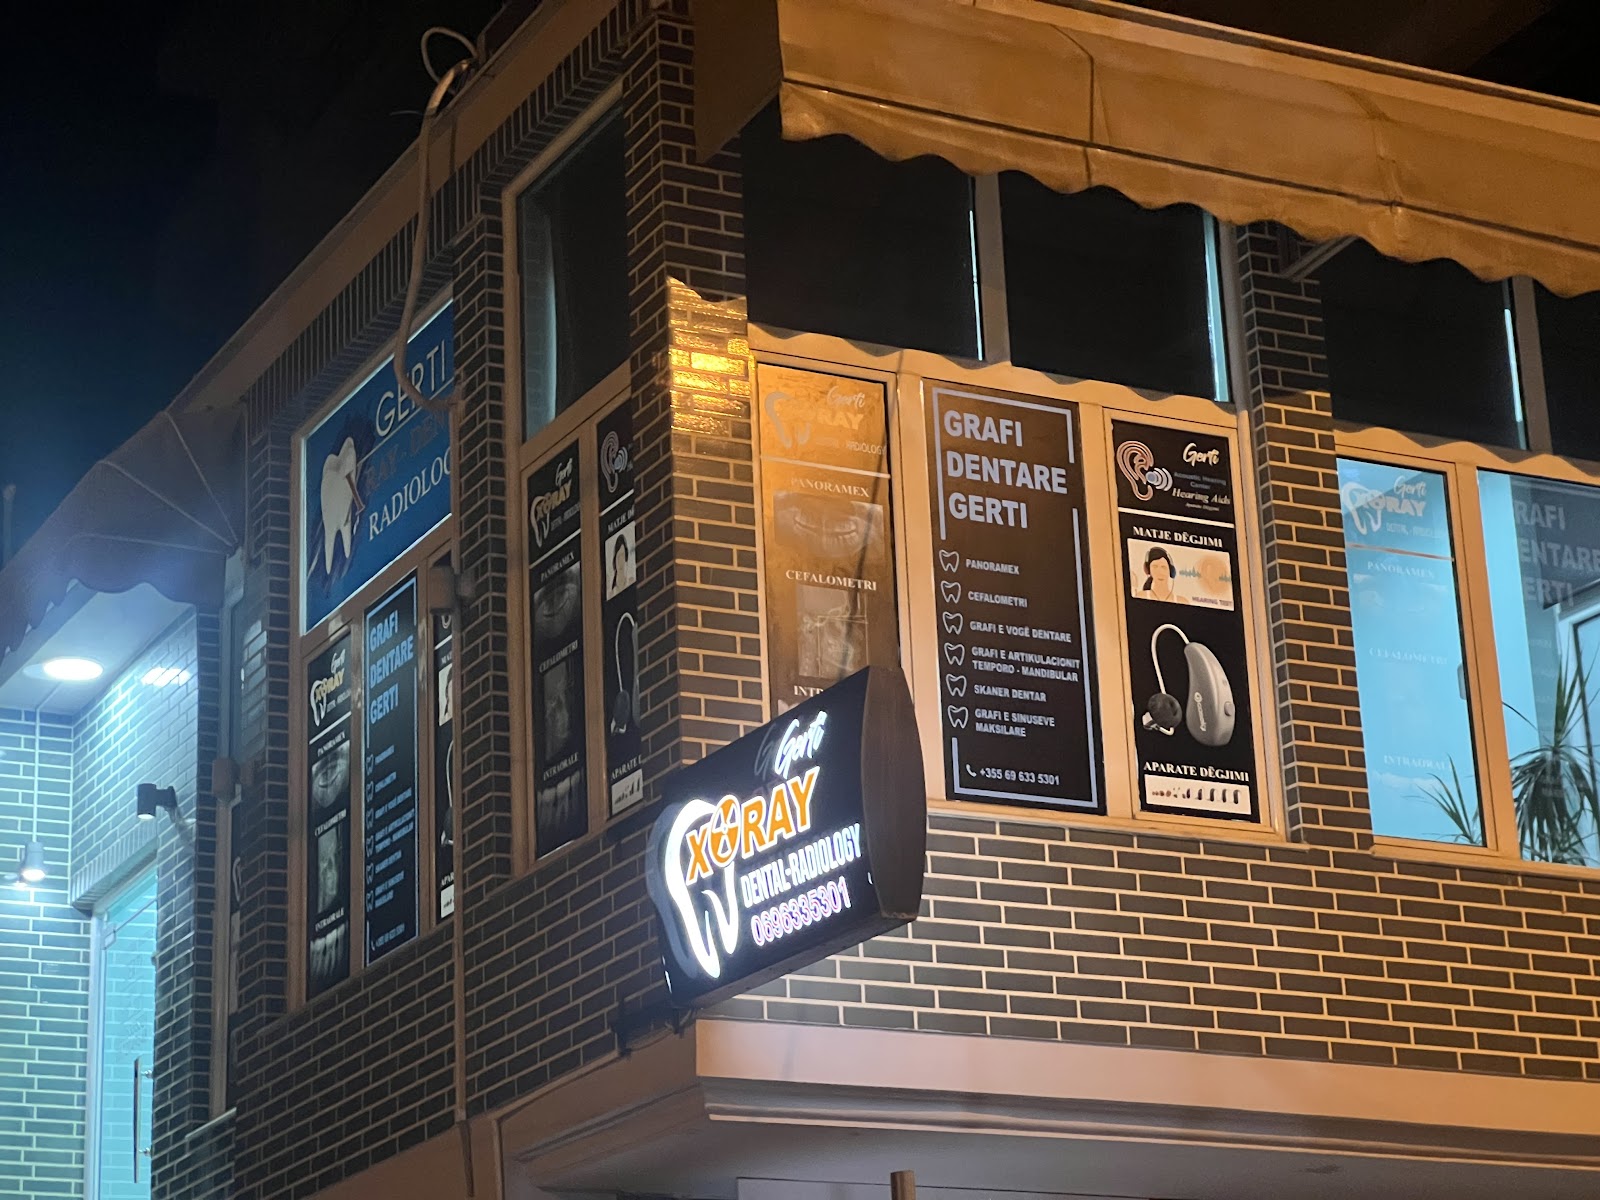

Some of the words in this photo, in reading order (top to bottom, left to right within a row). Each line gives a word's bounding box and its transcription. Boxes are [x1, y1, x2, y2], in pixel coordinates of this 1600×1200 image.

[817, 410, 864, 430] RAY
[944, 410, 1022, 447] GRAFI
[1183, 443, 1219, 467] Gerti
[947, 451, 1067, 494] DENTARE
[1172, 488, 1209, 503] Hearing
[1394, 475, 1427, 498] Gerti
[949, 492, 1027, 528] GERTI
[1514, 501, 1566, 530] RAFI
[1133, 526, 1172, 541] MATJE
[1519, 538, 1600, 573] ENTARE
[966, 559, 1019, 575] PANORAMEX
[786, 569, 877, 591] CEFALOMETRI
[968, 591, 1028, 608] CEFALOMETRI
[1523, 577, 1574, 607] ERTI
[369, 610, 398, 652] GRAFI
[970, 621, 996, 633] GRAFI
[998, 624, 1004, 634] E
[1032, 629, 1071, 643] DENTARE
[370, 634, 414, 689] DENTARE
[972, 646, 998, 659] GRAFI
[1000, 649, 1006, 659] E
[972, 660, 1014, 673] TEMPORO
[1022, 666, 1078, 682] MANDIBULAR
[370, 683, 398, 724] GERTI
[974, 684, 1009, 698] SKANER
[1012, 689, 1046, 702] DENTAR
[975, 708, 1001, 720] GRAFI
[1003, 711, 1009, 721] E
[1012, 712, 1055, 727] SINUSEVE
[975, 722, 1026, 737] MAKSILARE
[775, 711, 828, 779] Gerti
[980, 767, 1002, 780] +355
[1005, 770, 1016, 781] 69
[1019, 771, 1035, 783] 633
[1038, 773, 1060, 785] 5301
[1143, 761, 1197, 776] APARATE
[751, 875, 852, 946] 0696335301
